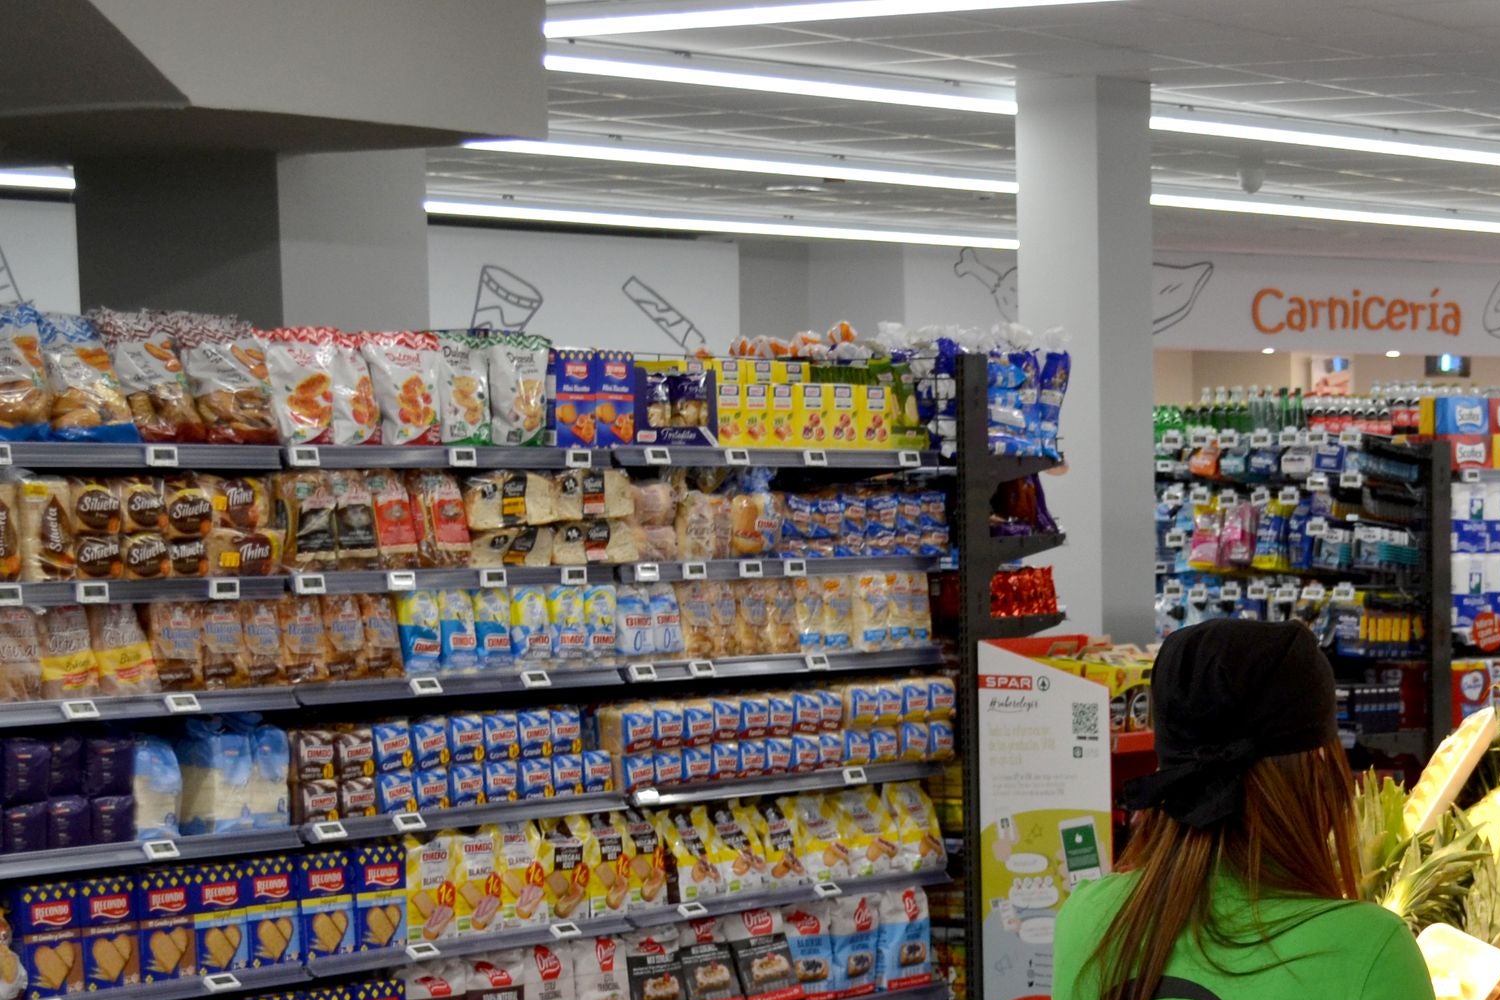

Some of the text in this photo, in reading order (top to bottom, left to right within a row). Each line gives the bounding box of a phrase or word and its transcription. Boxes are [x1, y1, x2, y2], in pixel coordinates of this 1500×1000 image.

[1251, 287, 1462, 336] Carnicería
[172, 502, 210, 519] Silueta
[240, 544, 270, 562] Thins
[985, 676, 1032, 688] SPAR
[311, 872, 342, 886] RECONDO
[368, 867, 398, 881] RECONDO
[529, 864, 543, 883] 1€
[205, 885, 237, 900] RECONDO
[256, 878, 287, 892] RECONDO
[94, 898, 127, 913] RECONDO
[152, 891, 184, 907] RECONDO
[35, 904, 69, 920] RECONDO
